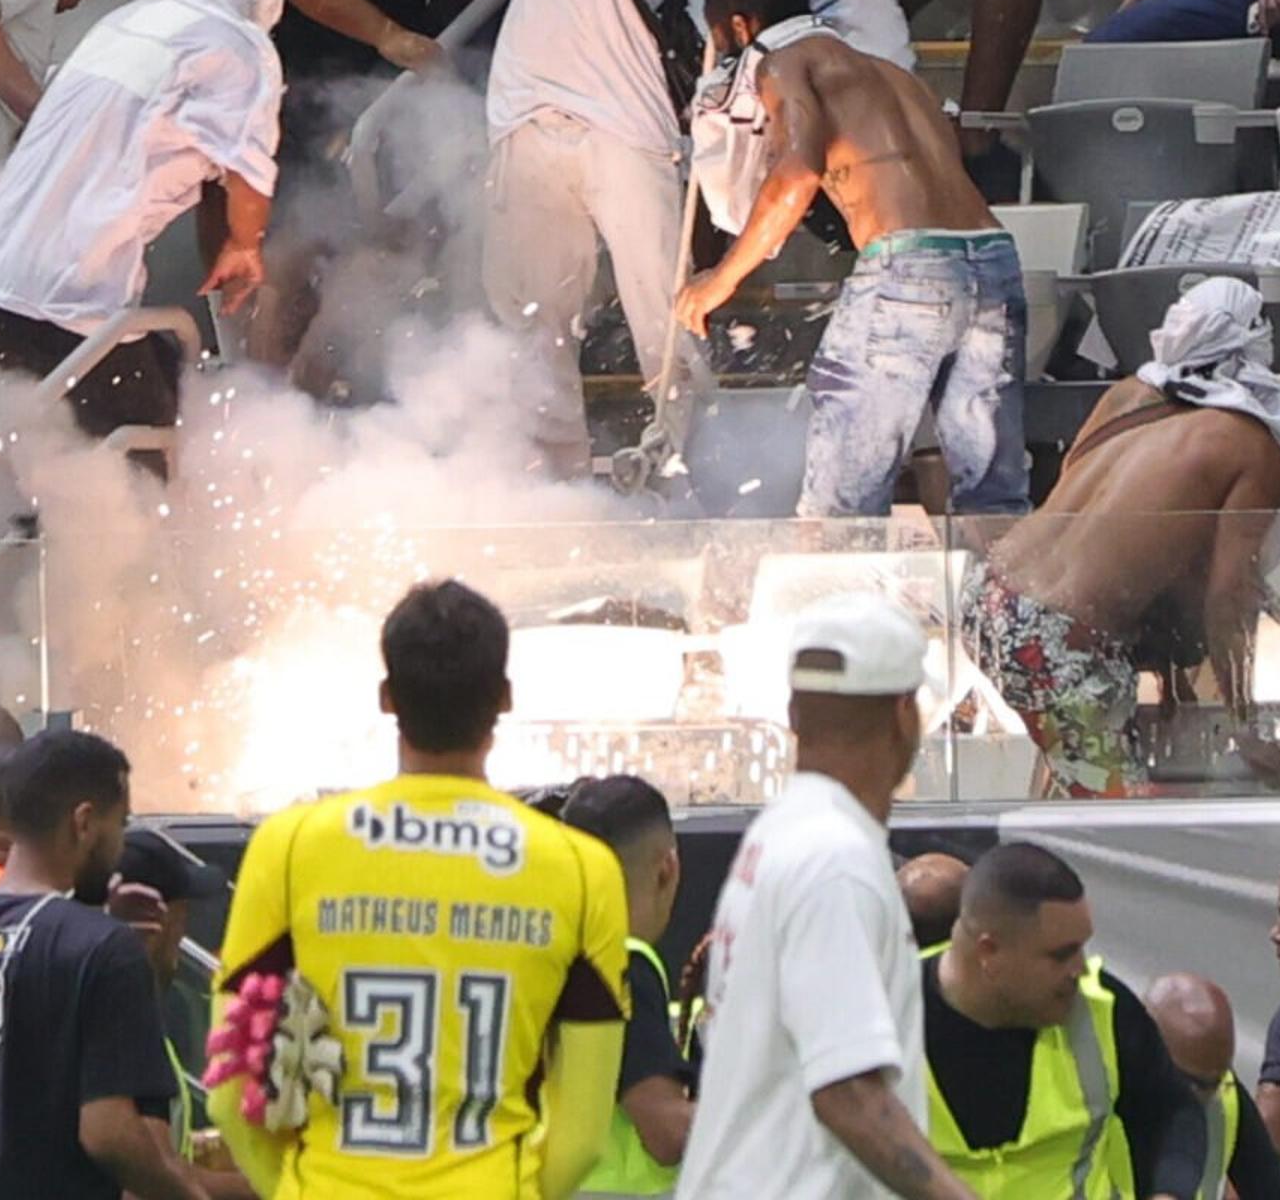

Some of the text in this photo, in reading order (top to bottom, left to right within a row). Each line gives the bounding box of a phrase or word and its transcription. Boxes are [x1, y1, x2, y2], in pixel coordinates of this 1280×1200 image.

[394, 805, 518, 869] bmg
[318, 896, 554, 948] MATHEUS MENDES
[341, 969, 509, 1155] 31
